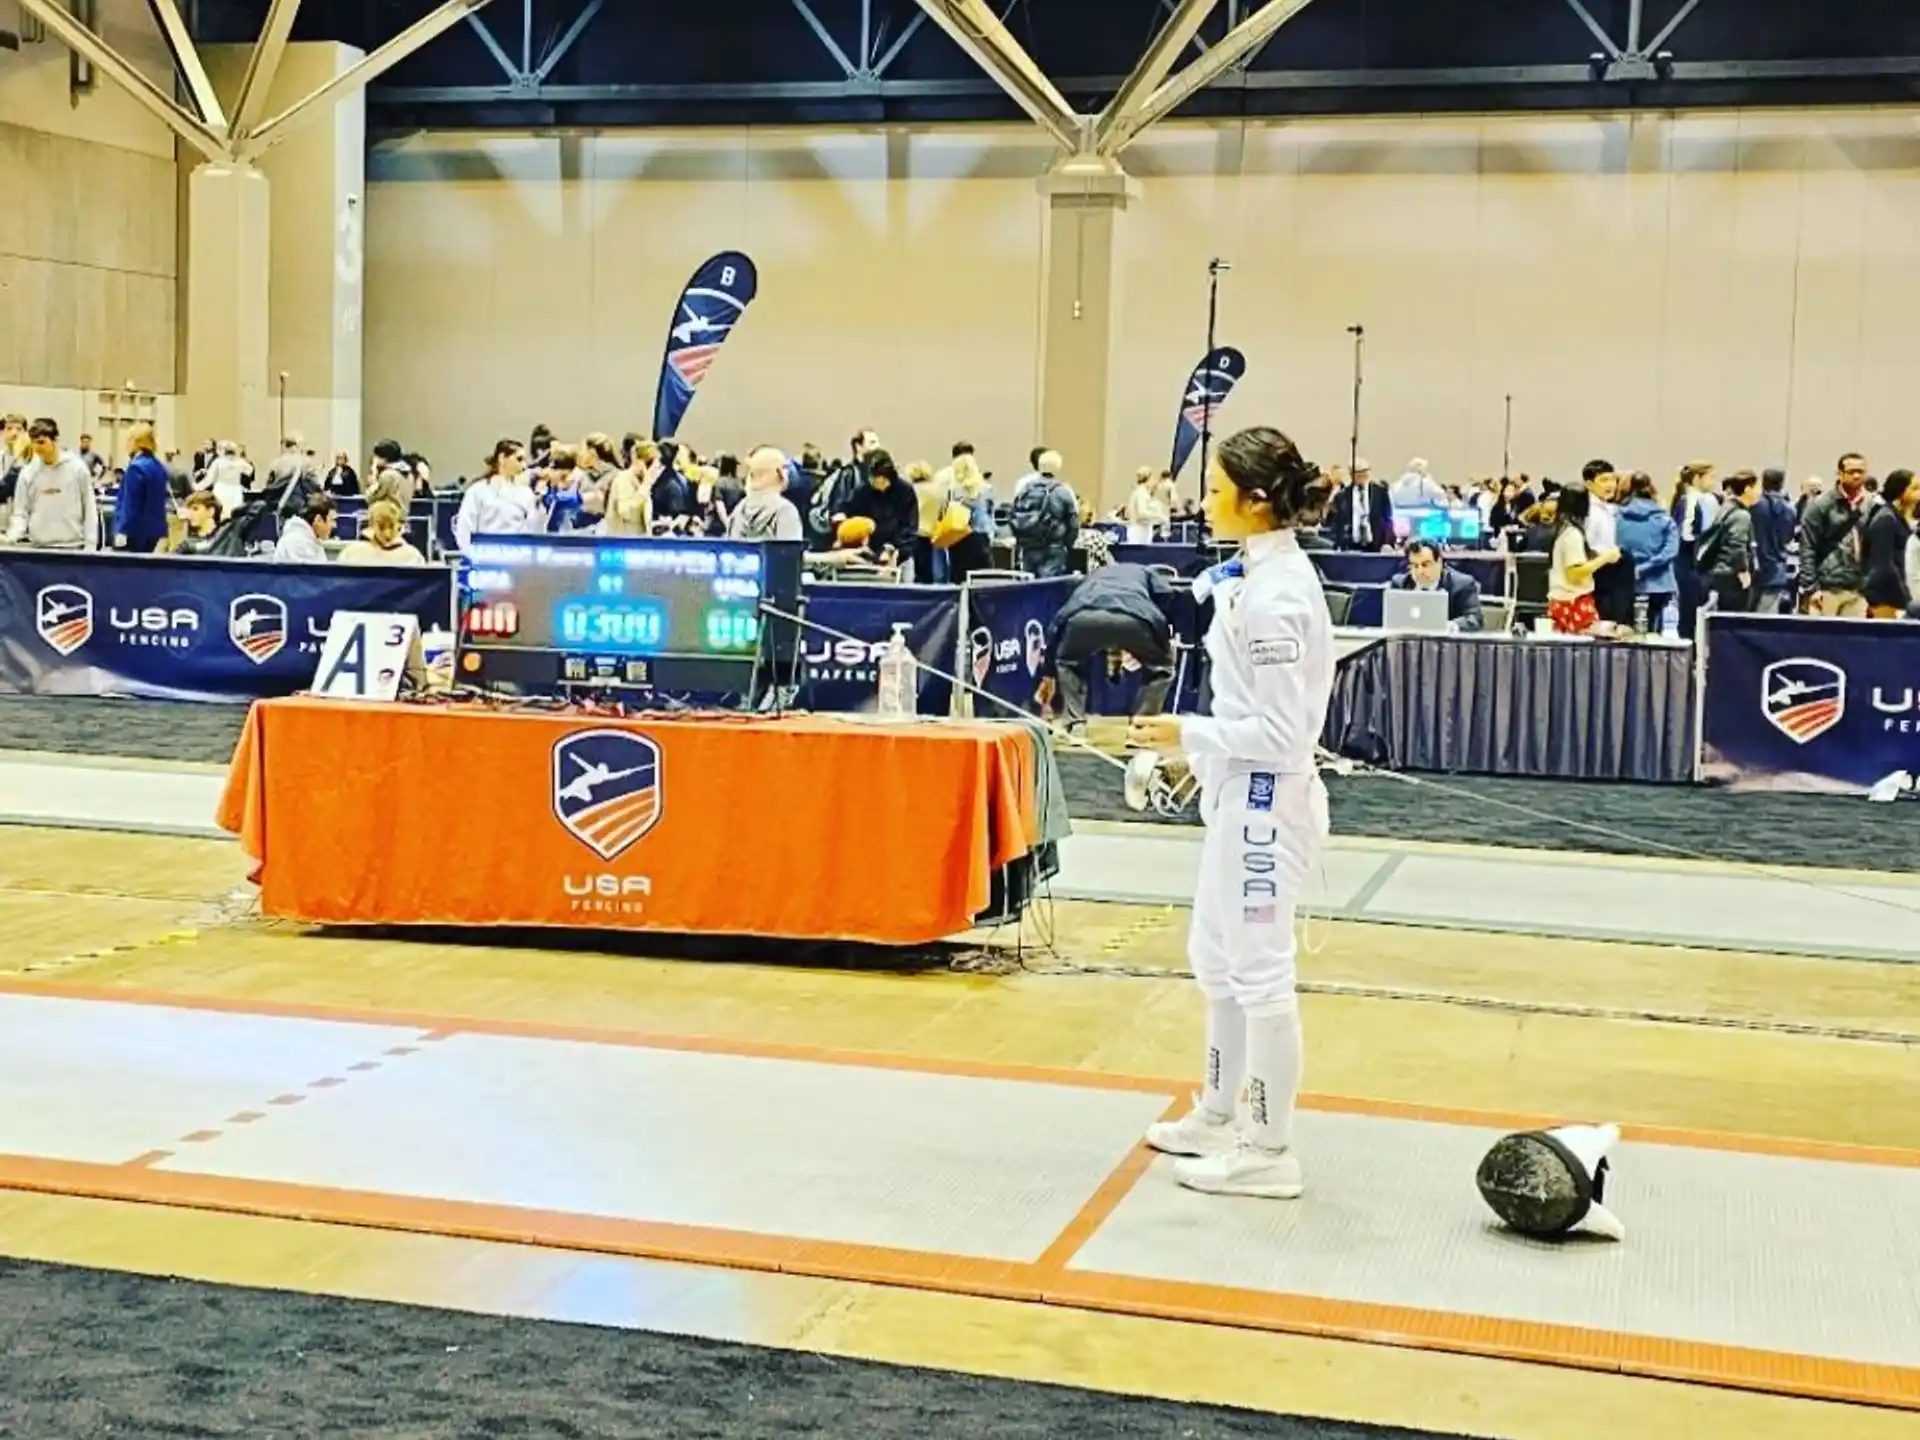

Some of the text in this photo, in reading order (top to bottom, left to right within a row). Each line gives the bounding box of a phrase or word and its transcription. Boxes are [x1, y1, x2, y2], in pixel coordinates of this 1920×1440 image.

[720, 265, 736, 287] B
[1219, 355, 1231, 369] D
[110, 606, 199, 631] USA
[384, 624, 405, 646] 3
[320, 623, 366, 695] A
[1243, 825, 1277, 897] USA
[563, 873, 652, 896] USA
